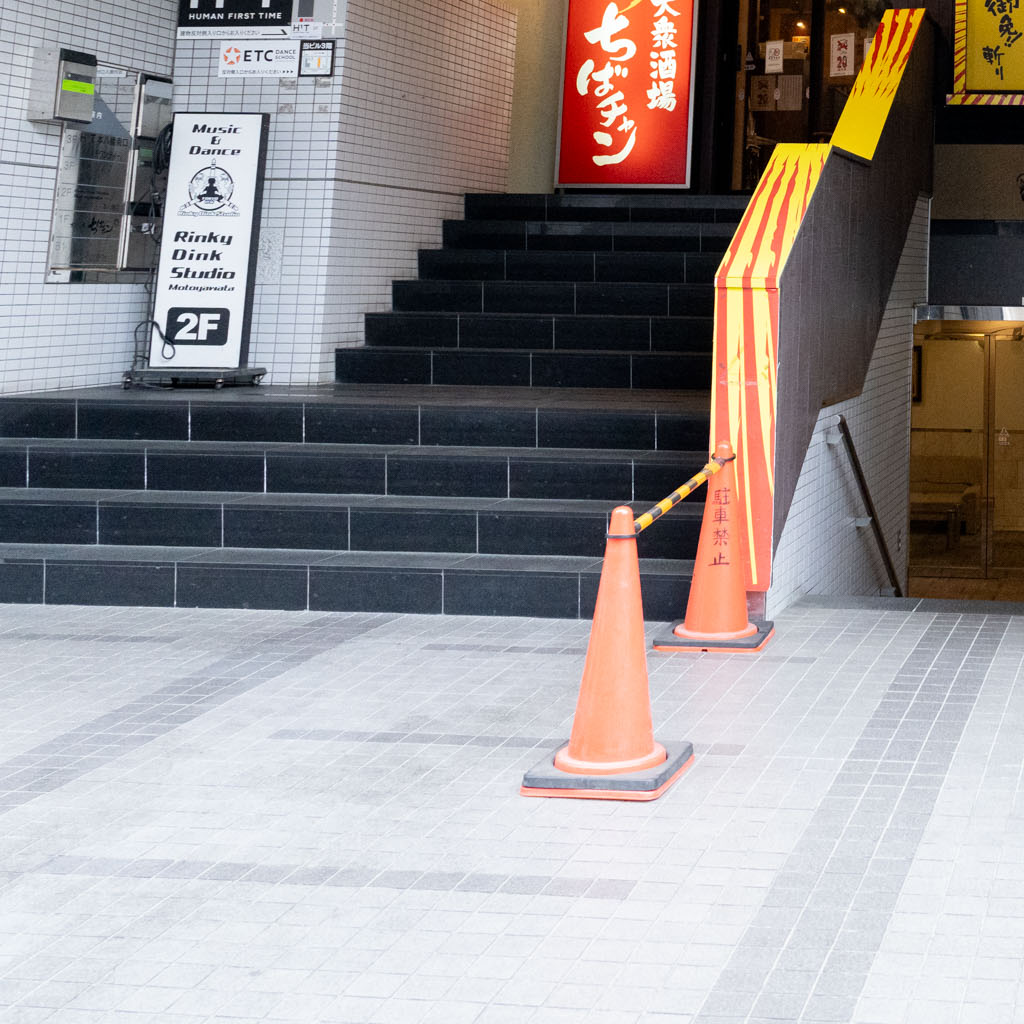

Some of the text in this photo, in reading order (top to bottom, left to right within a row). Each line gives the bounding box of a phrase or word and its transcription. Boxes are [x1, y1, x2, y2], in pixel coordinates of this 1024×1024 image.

[188, 12, 282, 20] HUMAN FIRST TIME
[243, 50, 274, 62] ETC
[982, 45, 1005, 80] 斬り
[576, 2, 638, 166] ちばチャン
[192, 123, 243, 135] Music
[210, 135, 221, 145] &
[189, 145, 242, 156] Dance
[173, 231, 234, 246] Rinky
[171, 249, 223, 261] Dink
[169, 267, 236, 280] Studio
[174, 312, 221, 341] 2F
[708, 487, 731, 566] 駐車禁止
